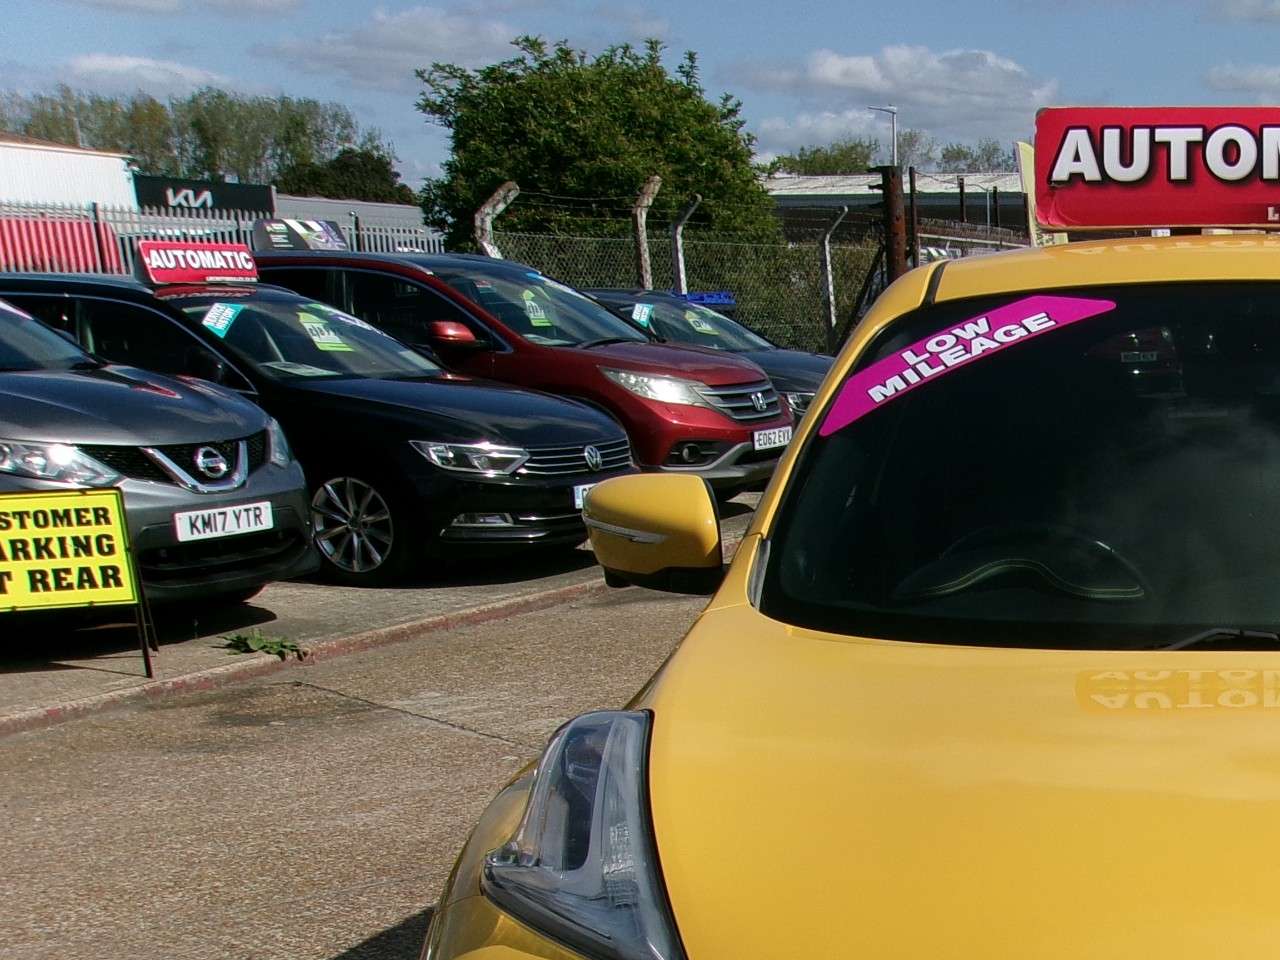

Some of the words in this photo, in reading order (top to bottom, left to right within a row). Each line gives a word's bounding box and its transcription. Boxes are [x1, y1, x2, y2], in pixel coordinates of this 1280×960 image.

[150, 250, 254, 270] AUTOMATIC
[901, 317, 990, 366] LOW
[868, 312, 1057, 403] MILEAGE
[188, 511, 228, 536] KM17
[231, 506, 264, 530] YTR
[27, 565, 124, 593] REAR
